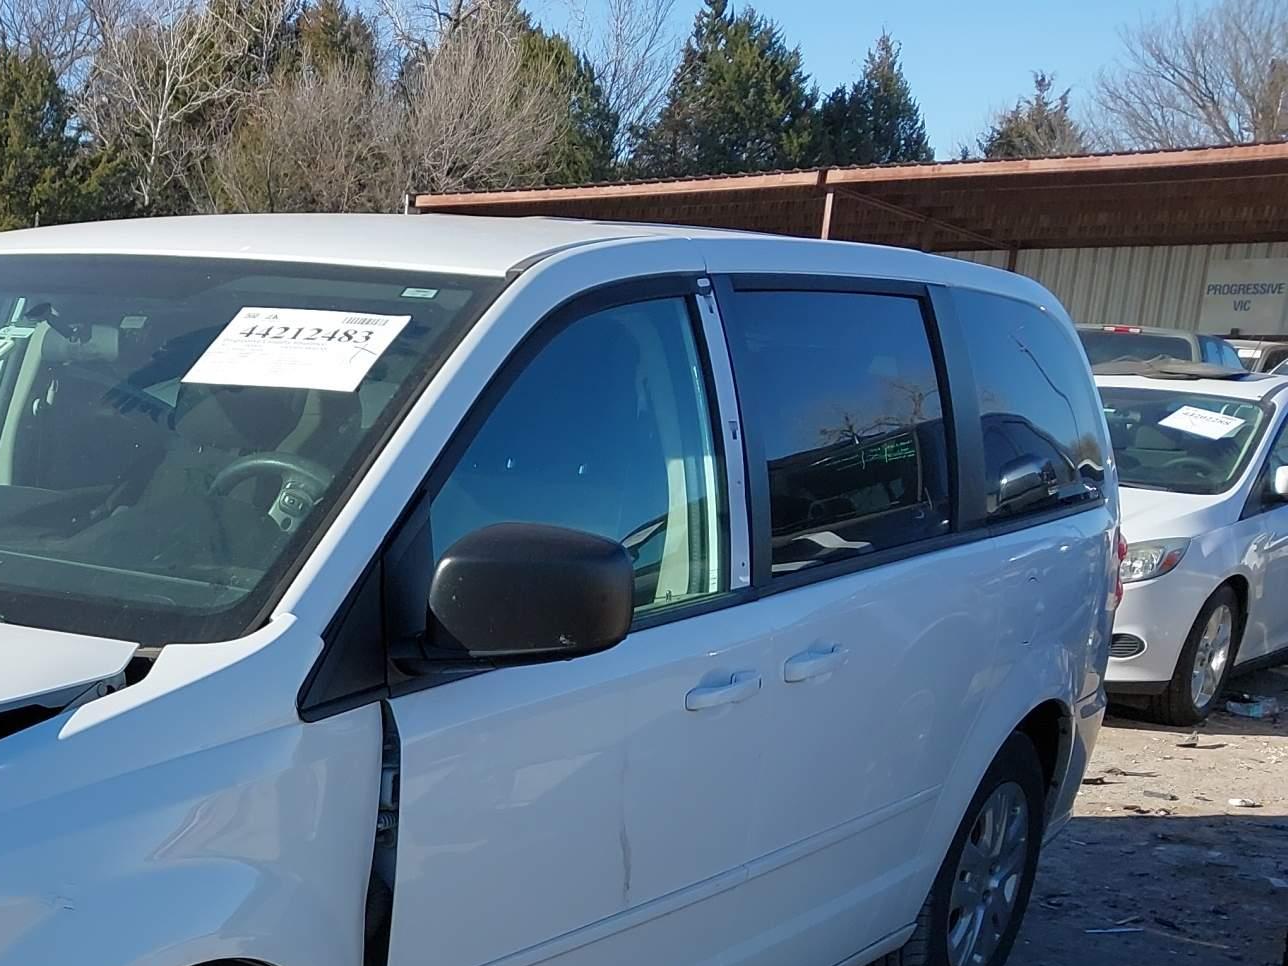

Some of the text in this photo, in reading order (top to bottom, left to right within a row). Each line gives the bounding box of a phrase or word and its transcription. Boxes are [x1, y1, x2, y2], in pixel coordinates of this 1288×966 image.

[1207, 283, 1285, 295] PROGRESSIVE
[1233, 300, 1251, 311] VIC
[239, 325, 375, 344] 44212483
